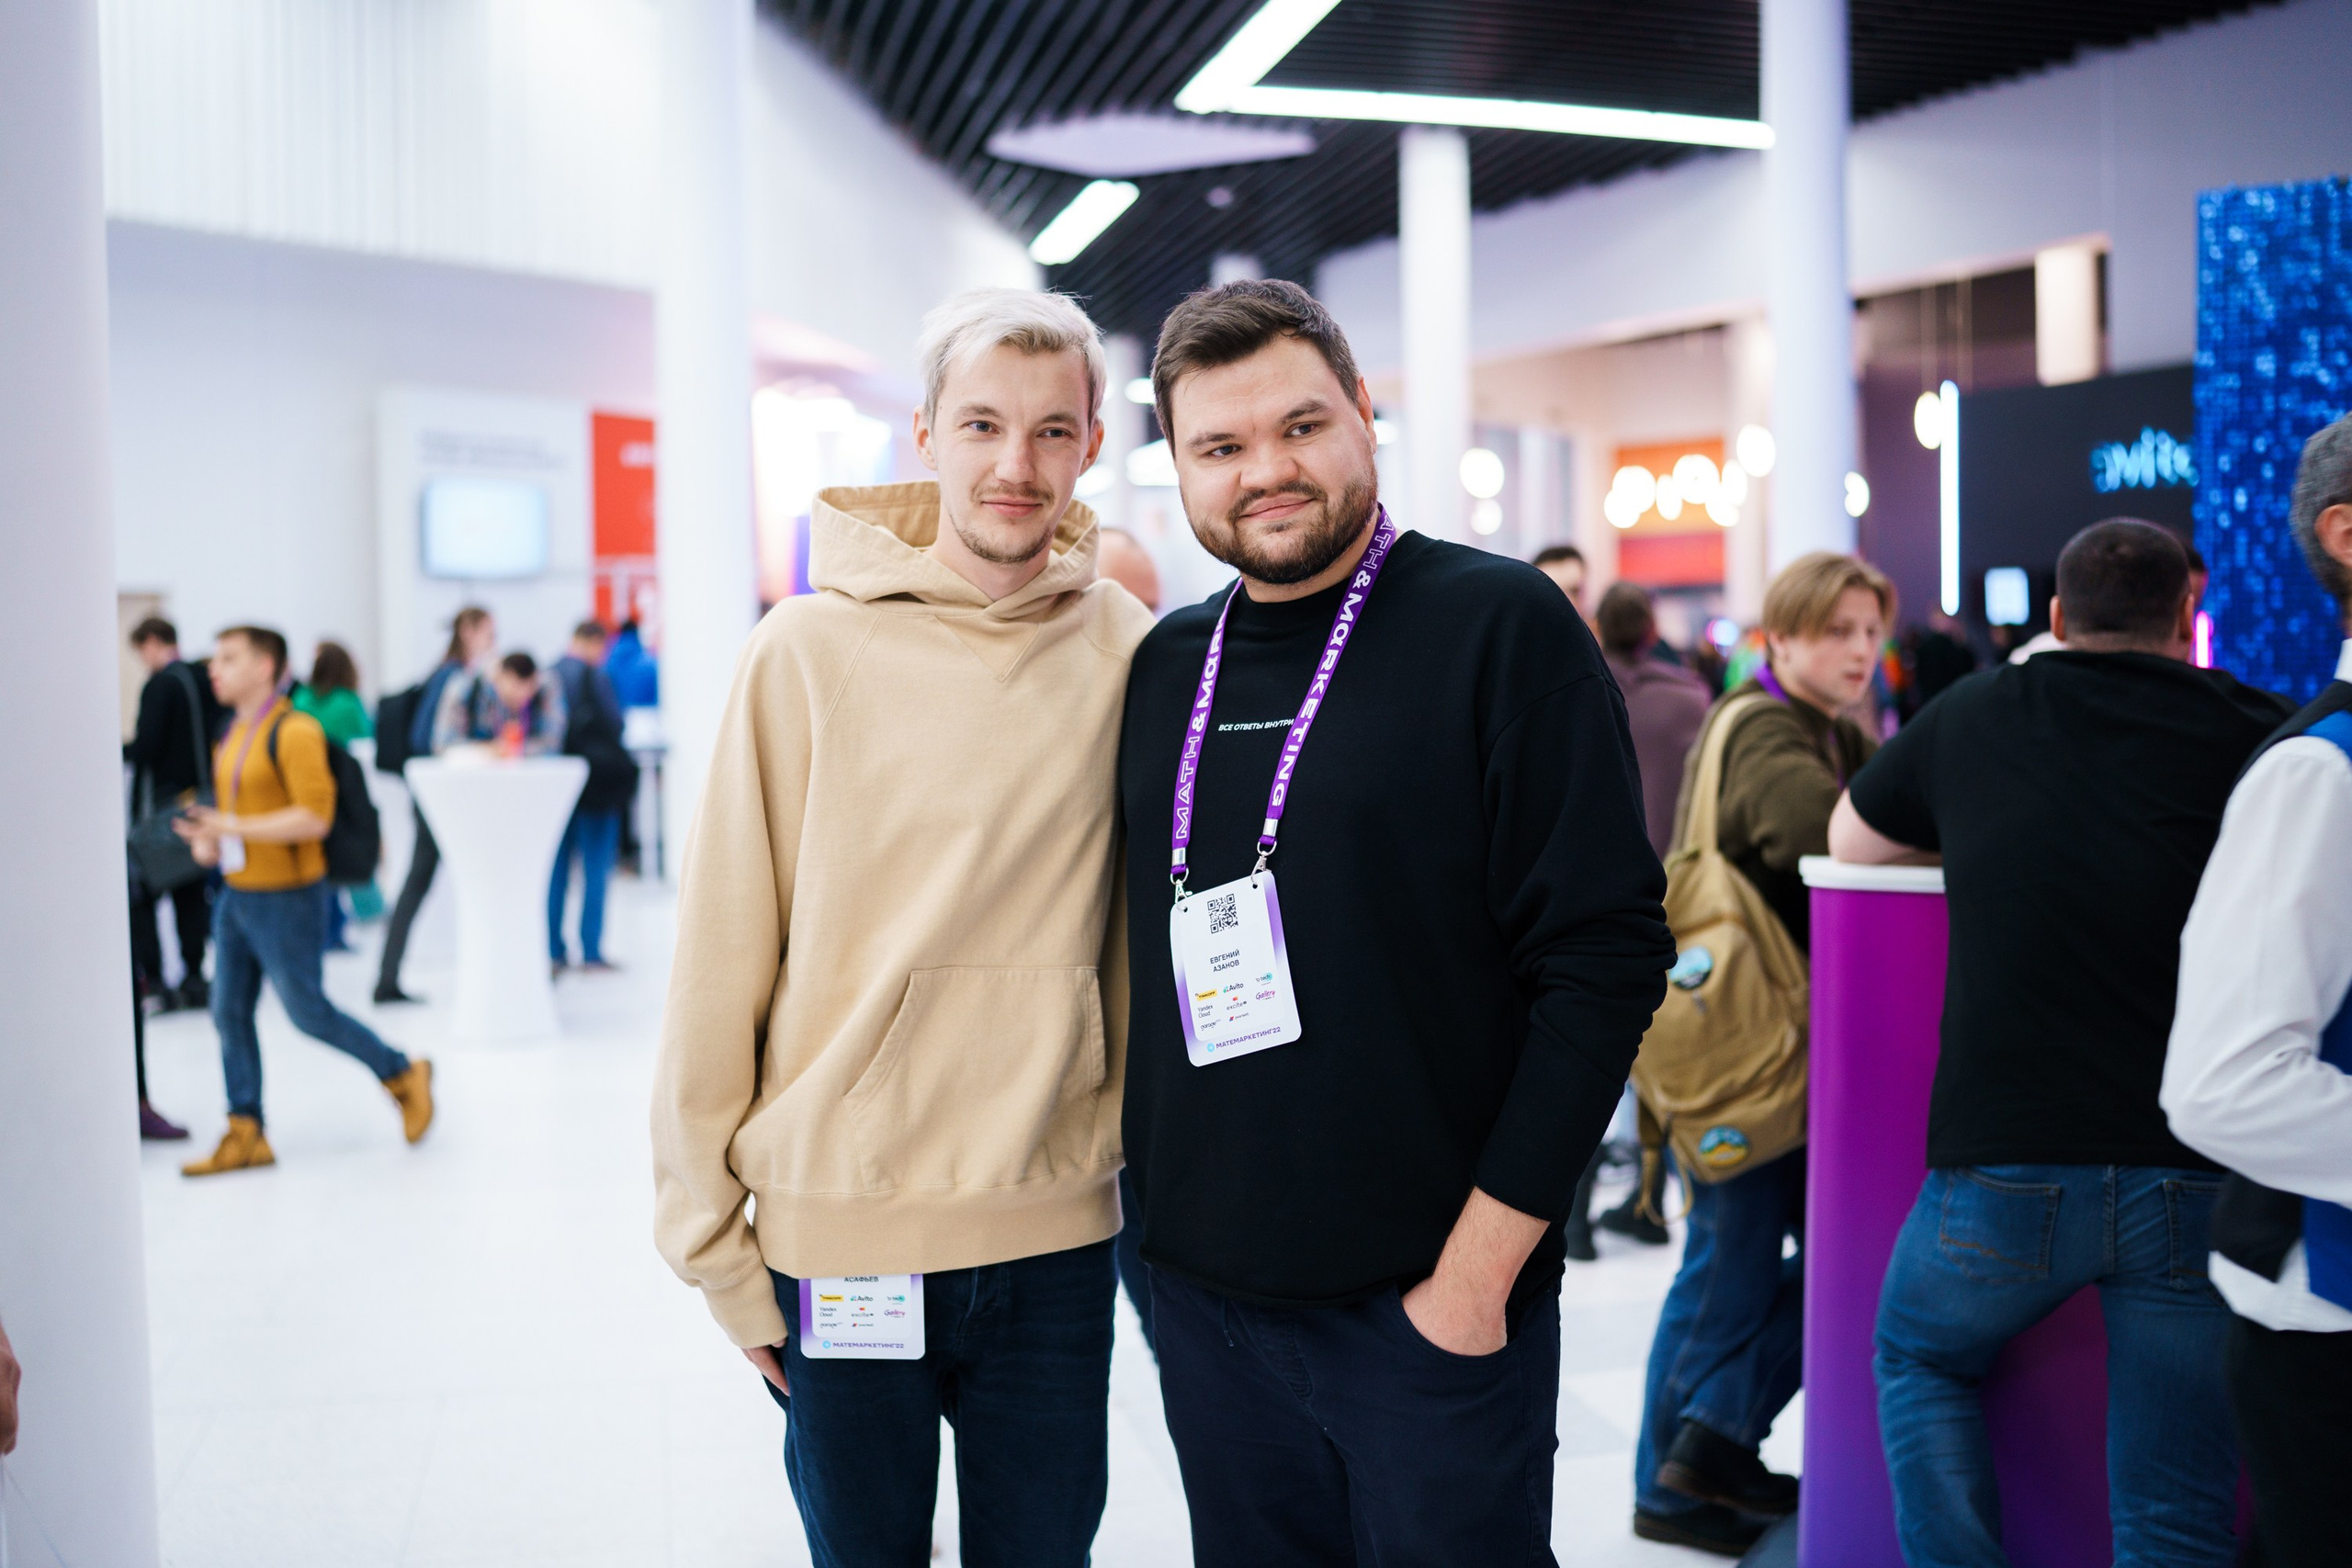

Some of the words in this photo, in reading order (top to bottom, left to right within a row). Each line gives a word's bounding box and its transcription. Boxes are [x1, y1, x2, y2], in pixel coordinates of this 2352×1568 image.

[1363, 514, 1394, 570] ATH
[1352, 570, 1371, 589] &
[1233, 722, 1264, 731] ОТВЕТЫ
[1264, 718, 1295, 728] ВНУТРИ
[1175, 736, 1200, 840] MATH
[1192, 711, 1206, 732] &
[1210, 949, 1239, 964] ЕВГЕНИЙ
[1213, 959, 1240, 973] АЗАНОВ
[1228, 982, 1244, 992] Avito
[1197, 1004, 1214, 1012] Yandex
[1198, 1010, 1211, 1019] Cloud
[1216, 1026, 1281, 1048] МАТЕМАРКЕТИНГ22
